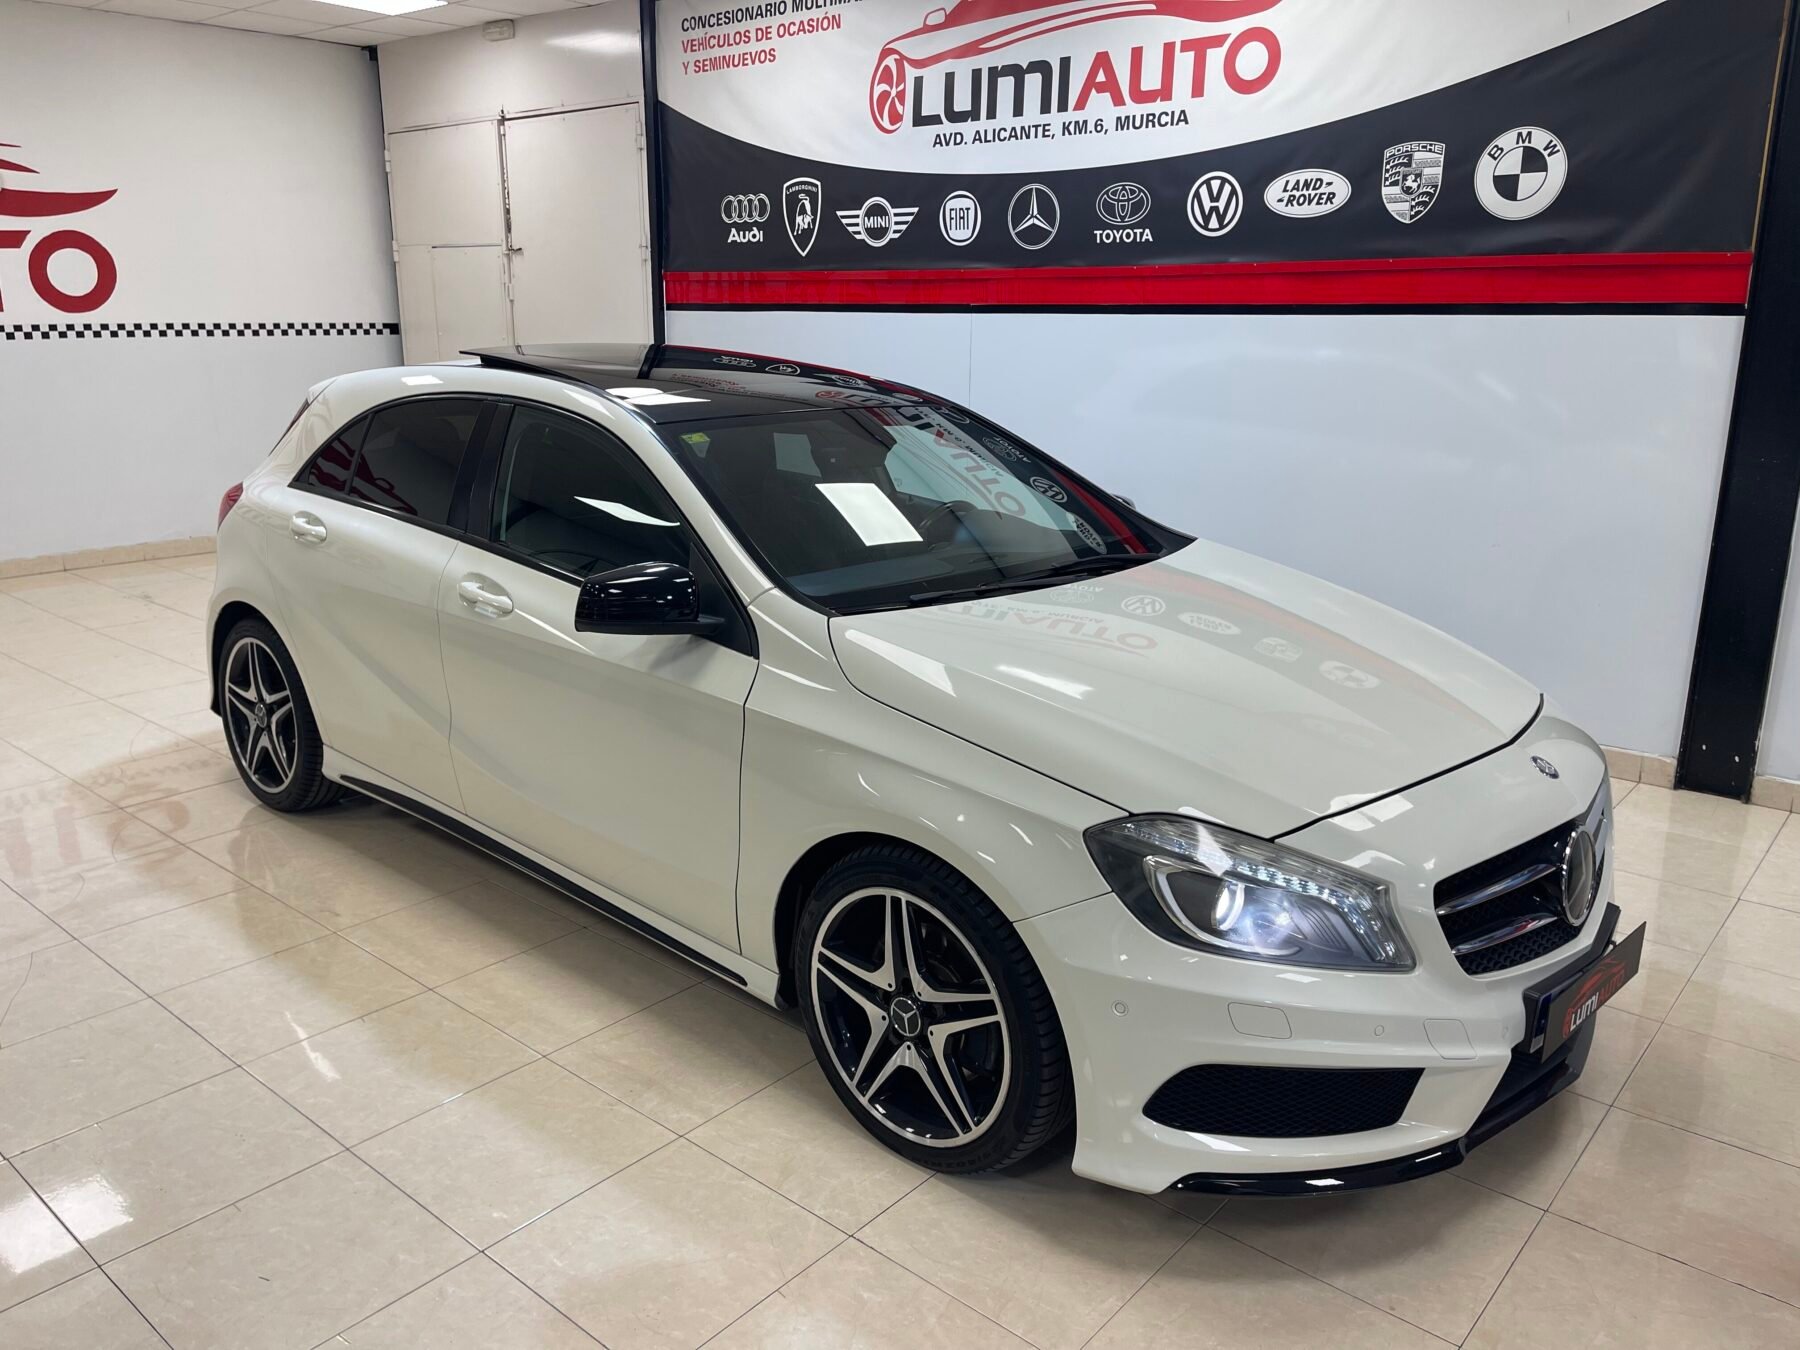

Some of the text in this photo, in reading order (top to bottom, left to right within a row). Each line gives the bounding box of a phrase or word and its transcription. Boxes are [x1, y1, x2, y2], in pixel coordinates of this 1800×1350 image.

[681, 0, 787, 32] CONCESIONARIO
[682, 12, 841, 54] VEHÍCULOS DE OCASIÓN
[683, 48, 776, 75] Y SEMINUEVOS
[932, 109, 1190, 148] AVD. ALICANTE, KM.6, MURCIA
[1386, 143, 1443, 159] PORSCHE
[1487, 130, 1560, 161] BMW
[786, 184, 818, 195] LAMBORGHINI
[1282, 177, 1324, 193] LAND
[1285, 191, 1336, 208] ROVER
[864, 215, 889, 229] MINI
[949, 206, 971, 231] FIAT
[727, 227, 764, 243] Audi
[1093, 228, 1153, 243] TOYOTA
